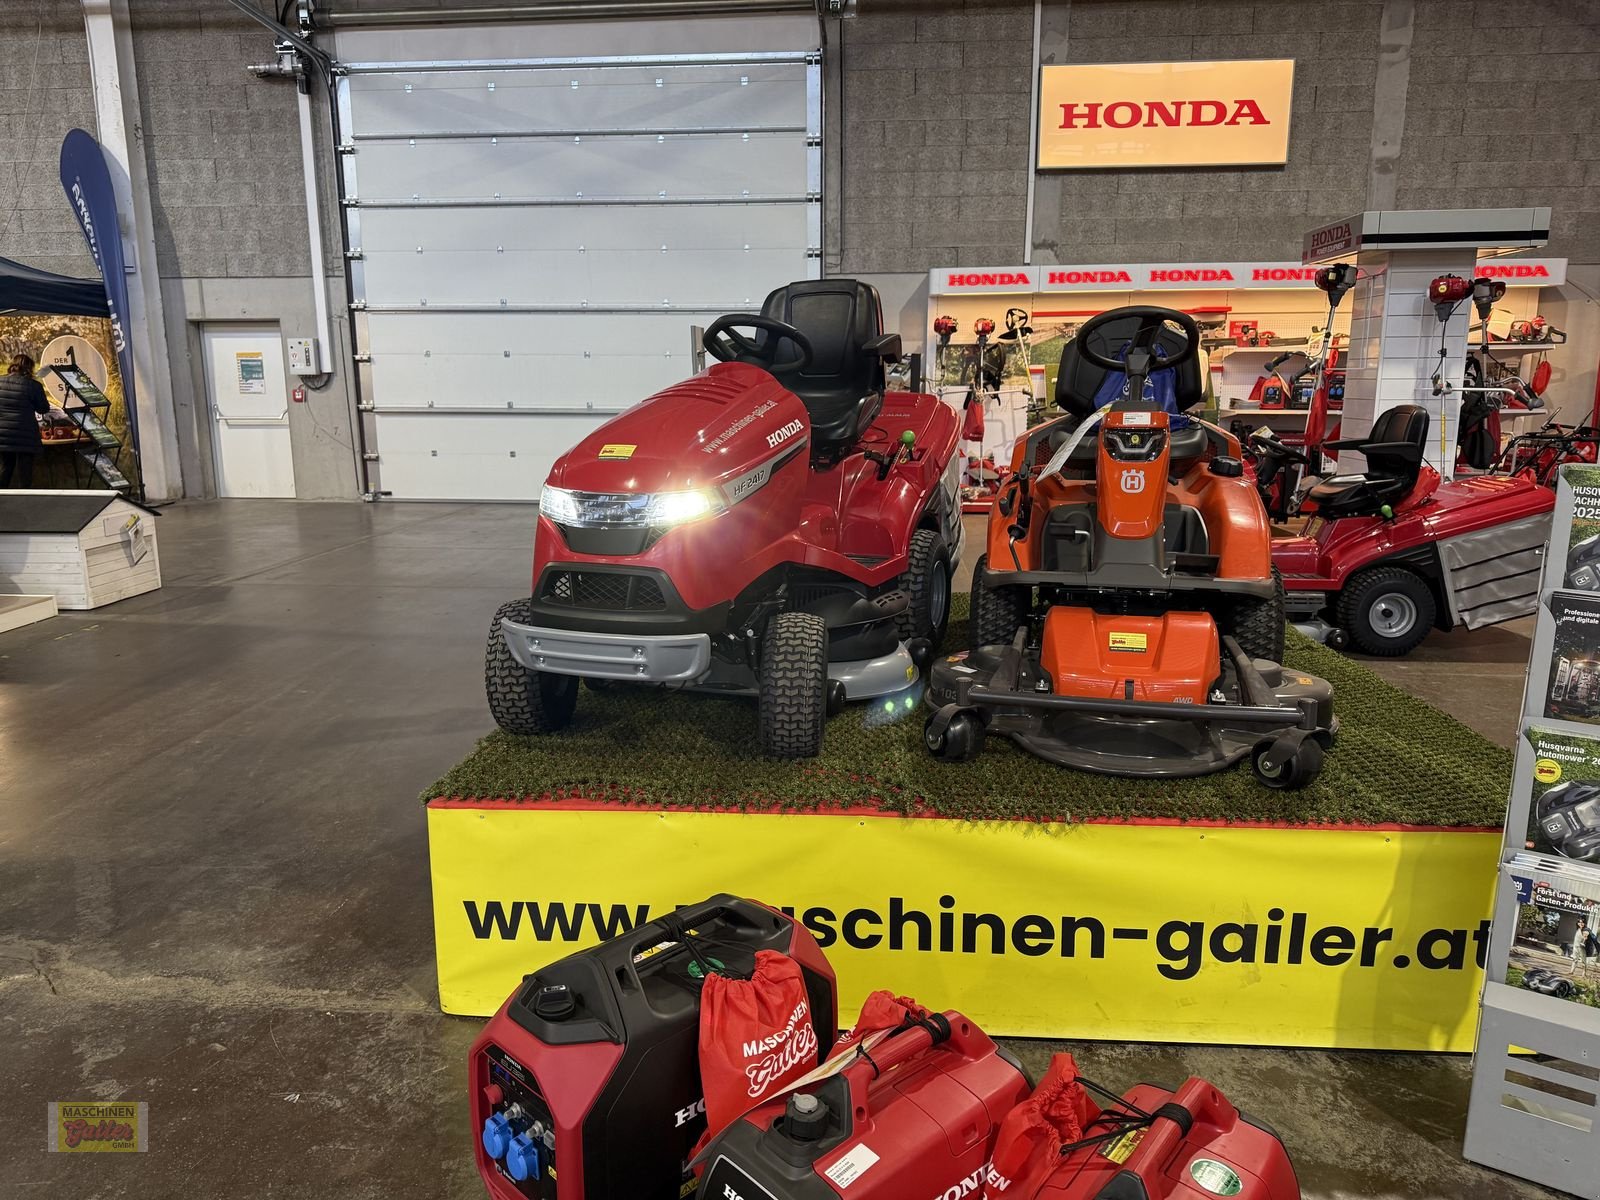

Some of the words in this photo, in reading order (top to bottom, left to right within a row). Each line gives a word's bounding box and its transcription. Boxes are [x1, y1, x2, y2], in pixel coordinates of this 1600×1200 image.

[1059, 99, 1270, 129] HONDA
[1312, 223, 1352, 248] HONDA
[948, 273, 1030, 287] HONDA
[1048, 270, 1132, 285] HONDA
[1150, 268, 1234, 283] HONDA
[766, 419, 804, 449] HONDA
[734, 483, 747, 497] HF
[747, 470, 765, 489] 2417
[1173, 696, 1194, 704] AWD
[1538, 740, 1585, 754] Husqvarna
[1537, 887, 1557, 897] Forst
[1557, 892, 1572, 900] und
[1535, 894, 1599, 914] Garten-Produkte
